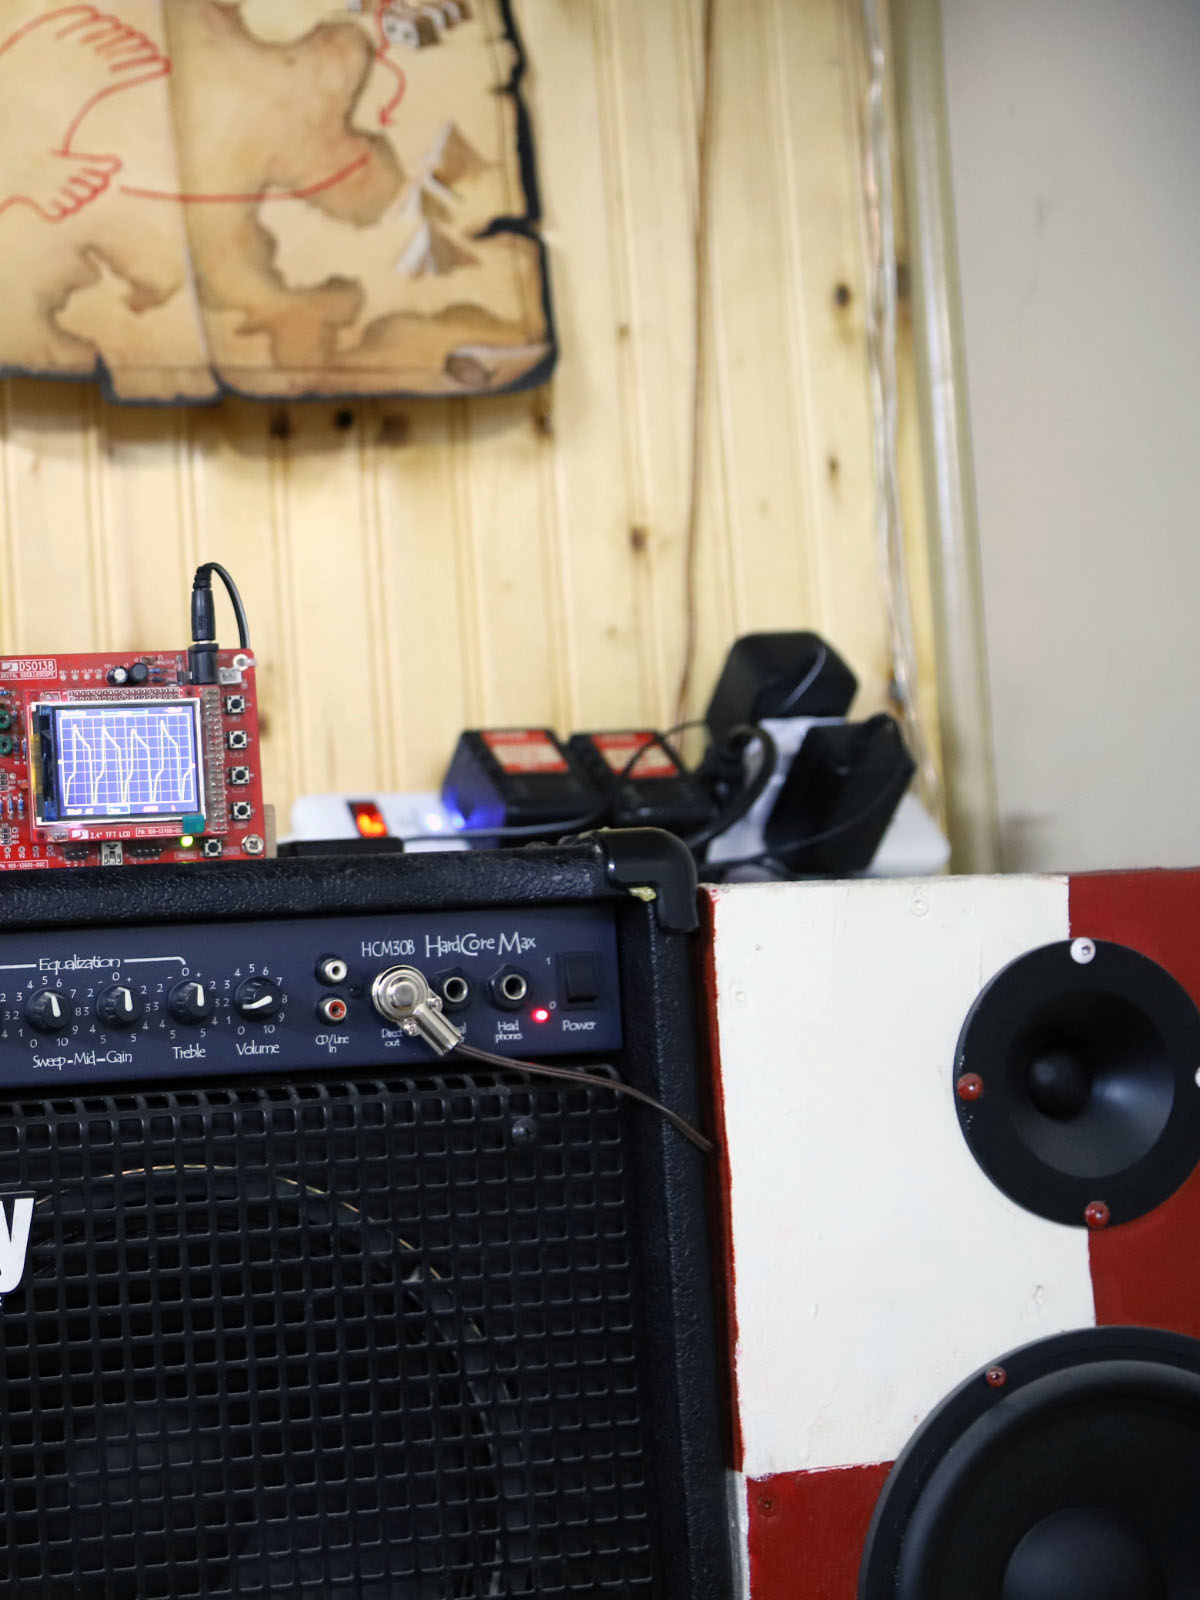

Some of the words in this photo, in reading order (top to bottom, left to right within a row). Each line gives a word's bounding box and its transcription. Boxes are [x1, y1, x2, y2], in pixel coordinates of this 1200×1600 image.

[19, 660, 54, 671] DSO138
[361, 939, 415, 957] HCM30B
[425, 933, 495, 958] HardCore
[498, 932, 536, 955] Max
[39, 954, 120, 975] Equalization
[249, 964, 254, 973] 5
[234, 968, 241, 976] 4
[262, 966, 269, 976] 6
[27, 980, 34, 989] 4
[42, 976, 48, 985] 5
[56, 979, 62, 988] 6
[210, 981, 216, 989] 2
[224, 980, 230, 989] 3
[276, 977, 282, 986] 7
[88, 988, 94, 997] 2
[141, 986, 147, 994] 2
[157, 984, 163, 992] 2
[0, 993, 6, 1002] 2
[16, 992, 22, 1001] 3
[70, 989, 76, 998] 7
[153, 1002, 158, 1010] 3
[224, 998, 229, 1006] 2
[5, 1011, 10, 1020] 3
[13, 1011, 19, 1020] 2
[75, 1007, 81, 1016] 8
[84, 1007, 89, 1016] 3
[212, 1017, 218, 1025] 4
[279, 1013, 284, 1022] 9
[89, 1024, 96, 1032] 4
[142, 1022, 149, 1030] 4
[160, 1020, 166, 1028] 4
[497, 1019, 520, 1031] Head
[562, 1019, 597, 1032] Power
[2, 1030, 8, 1038] 4
[72, 1025, 78, 1034] 9
[201, 1028, 206, 1037] 5
[238, 1026, 245, 1035] 0
[264, 1025, 275, 1034] 10
[131, 1034, 136, 1042] 5
[170, 1030, 176, 1039] 5
[495, 1031, 523, 1043] phones
[30, 1039, 37, 1048] 0
[57, 1038, 68, 1047] 10
[101, 1035, 106, 1044] 5
[385, 1038, 400, 1047] out
[172, 1043, 206, 1059] Treble
[236, 1040, 280, 1055] Volume
